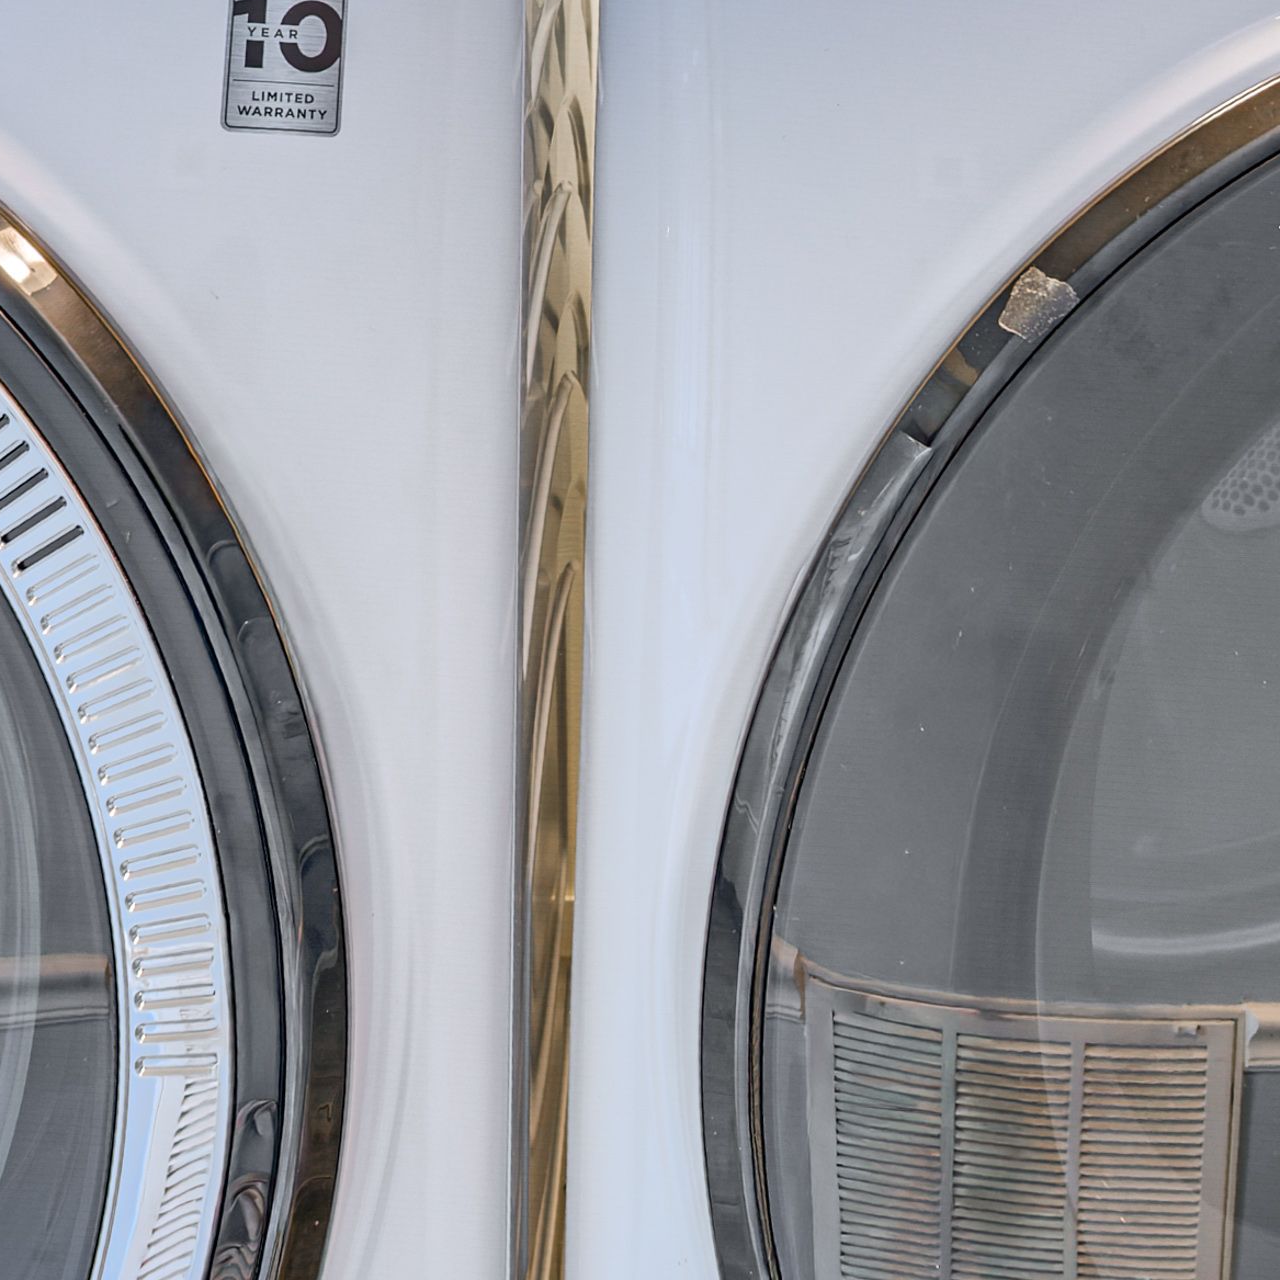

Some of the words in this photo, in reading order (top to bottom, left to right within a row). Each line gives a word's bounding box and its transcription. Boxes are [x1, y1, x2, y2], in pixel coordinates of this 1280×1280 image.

[248, 27, 298, 39] YEAR
[252, 91, 315, 104] LIMITED
[237, 105, 328, 120] WARRANTY
